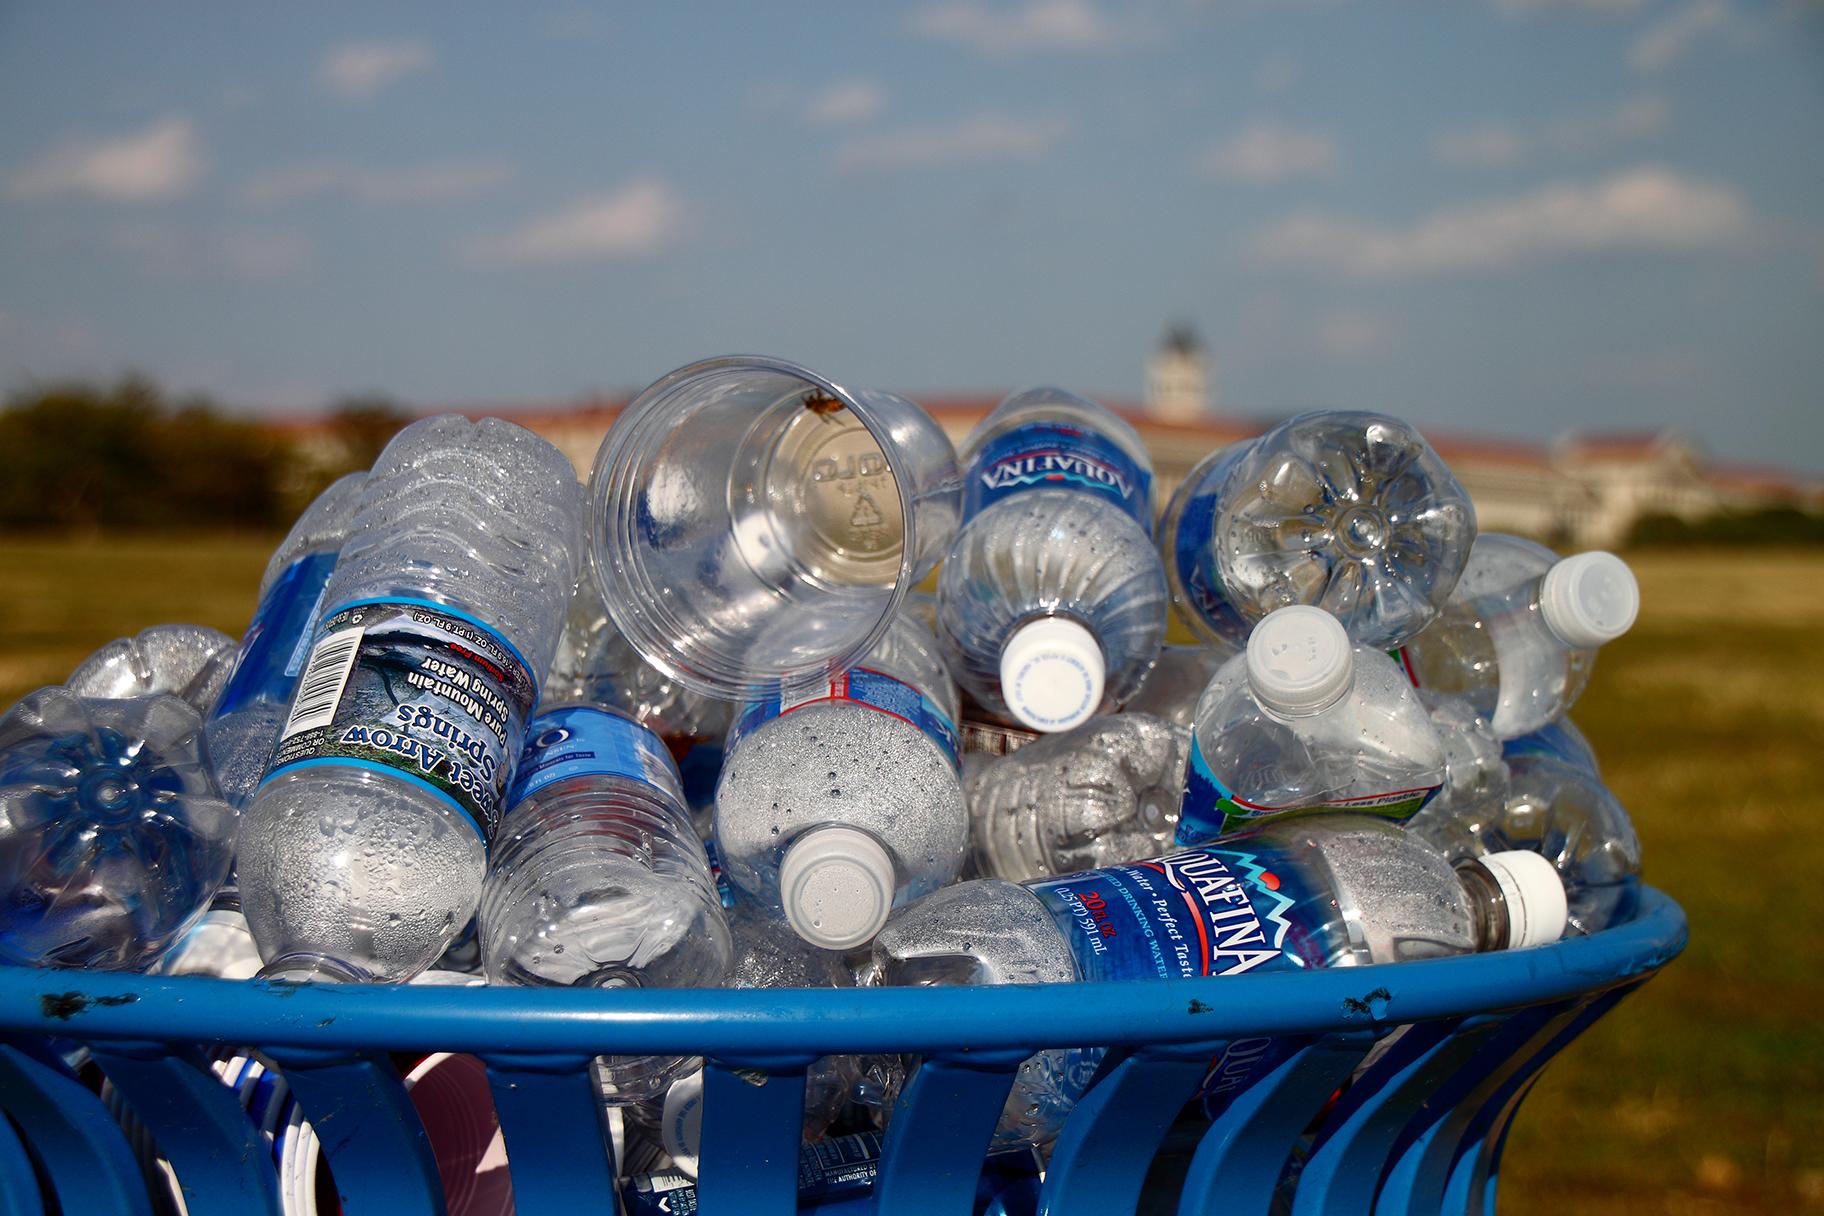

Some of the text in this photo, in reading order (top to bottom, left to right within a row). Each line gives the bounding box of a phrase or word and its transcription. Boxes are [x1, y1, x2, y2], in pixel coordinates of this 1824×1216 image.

[981, 454, 1134, 498] AQUAFINA
[449, 642, 474, 659] Free
[407, 671, 484, 722] Mountain
[421, 657, 472, 691] Water
[471, 678, 510, 724] Spring
[312, 737, 325, 746] OR
[397, 704, 495, 783] Springs
[484, 711, 508, 748] Pure
[340, 725, 499, 839] Sweet Arrow
[1077, 891, 1117, 939] 20 FL OZ
[1119, 886, 1154, 938] DRINKING
[1126, 869, 1154, 892] Water
[1152, 898, 1183, 941] Perfect
[1145, 852, 1281, 976] QUAFINA
[1078, 918, 1099, 935] 591
[1089, 937, 1108, 956] mL
[838, 1170, 868, 1182] AUTHORITY
